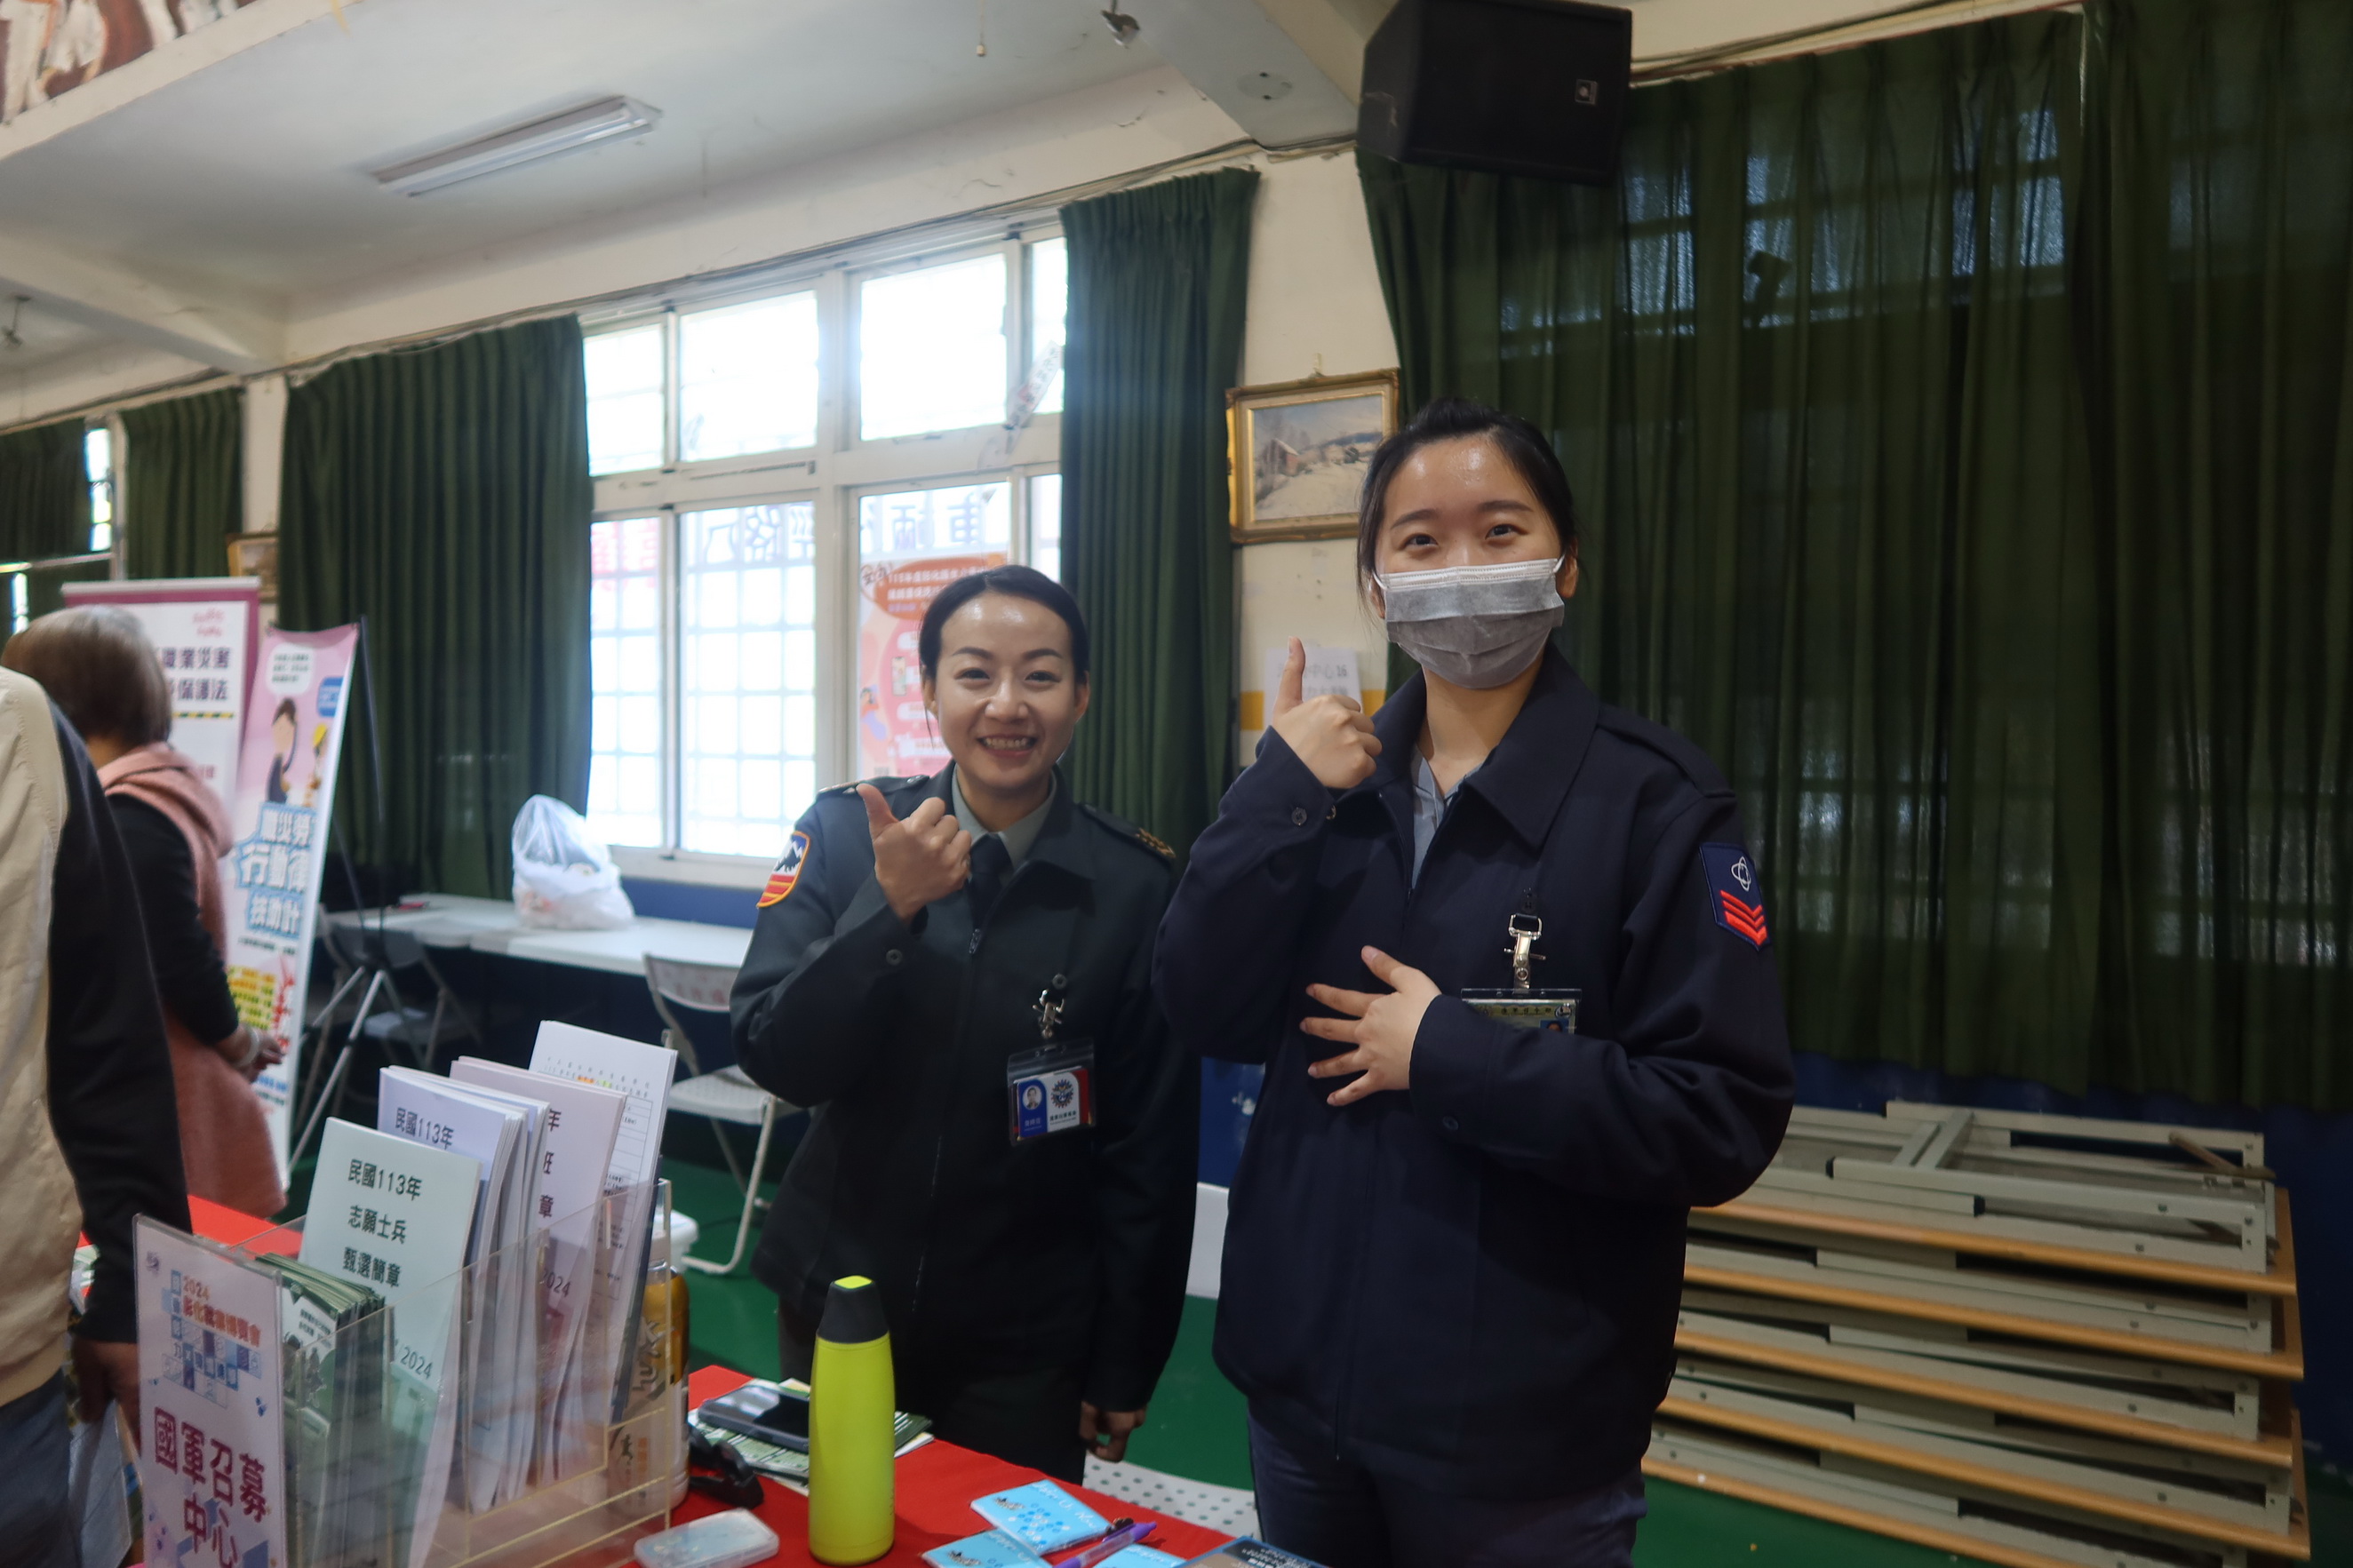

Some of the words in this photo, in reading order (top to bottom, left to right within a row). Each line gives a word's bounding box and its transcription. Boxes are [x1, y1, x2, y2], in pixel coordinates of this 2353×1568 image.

[171, 678, 228, 701] 保護法
[395, 1107, 455, 1150] 民國113年
[347, 1158, 423, 1201] 民國113年
[347, 1205, 408, 1245] 志願士兵
[183, 1275, 211, 1301] 2024
[342, 1246, 402, 1288] 甄選簡章
[400, 1346, 433, 1380] 2024
[154, 1406, 267, 1524] 國軍召募
[183, 1492, 239, 1568] 中心
